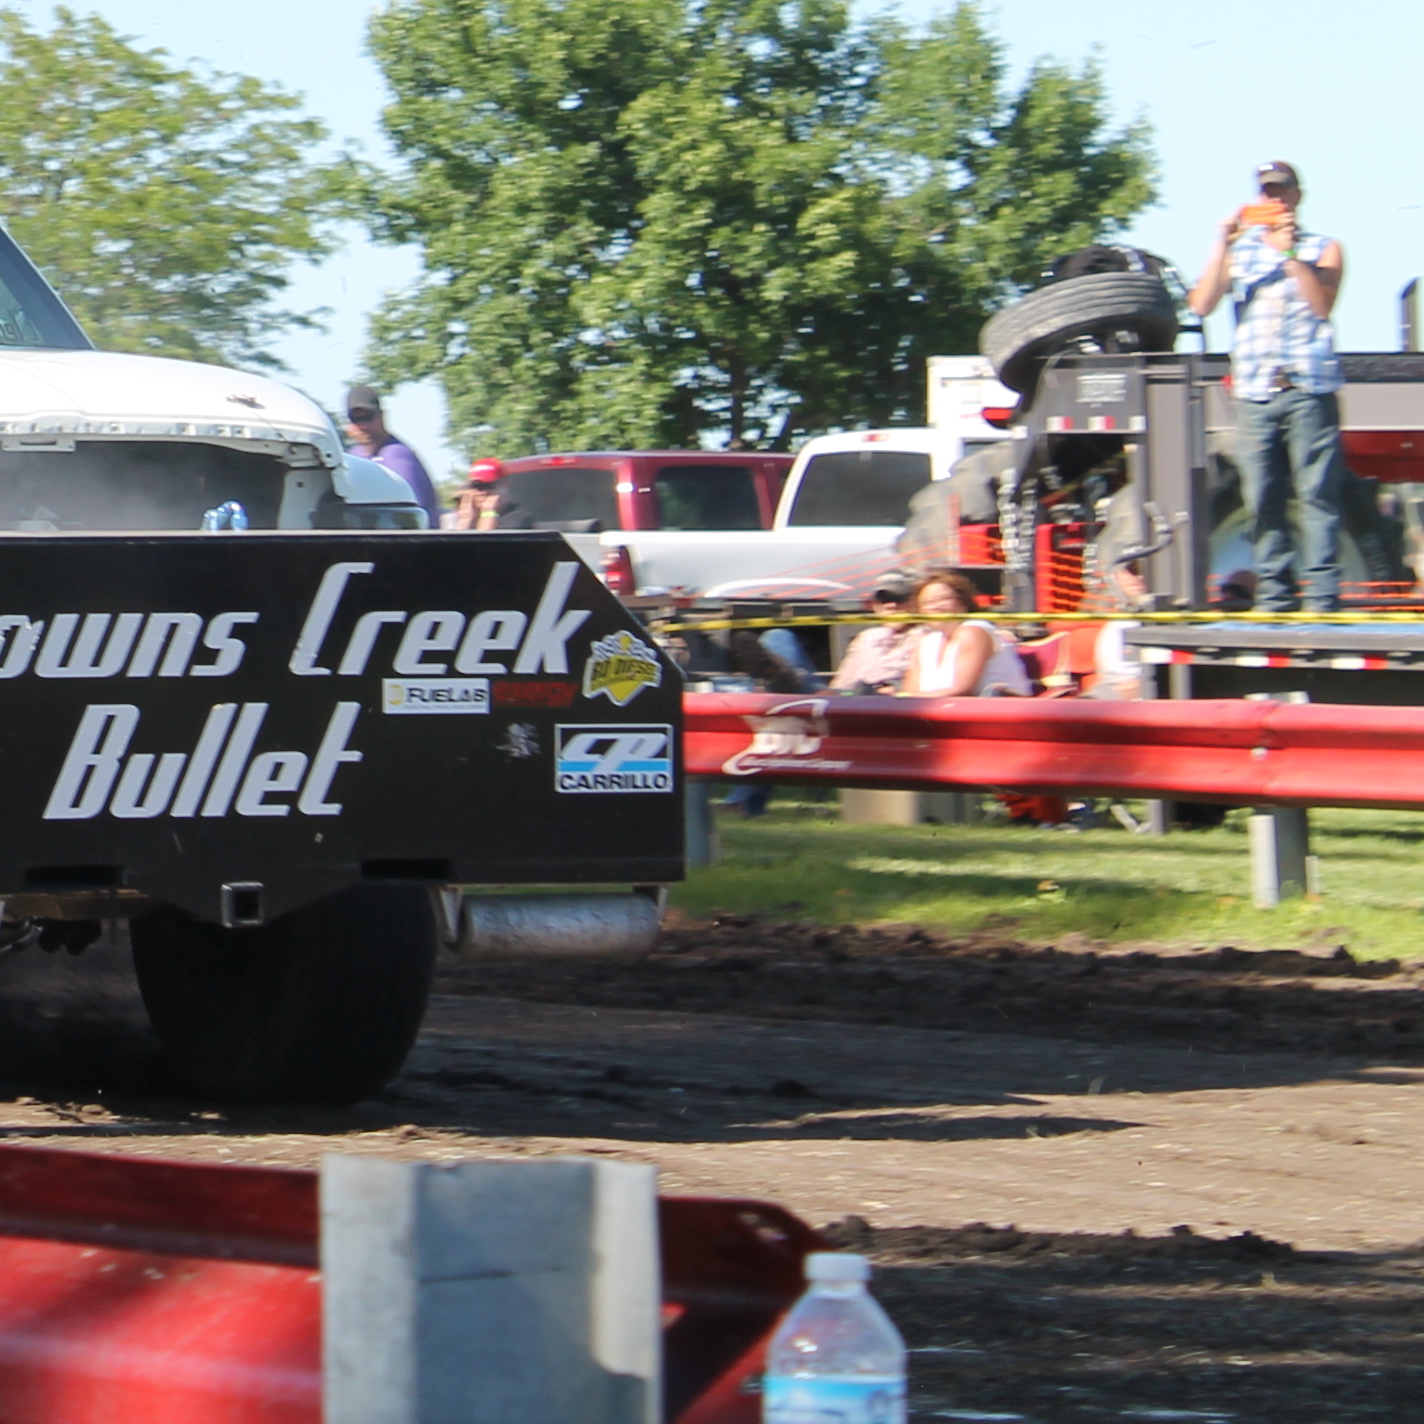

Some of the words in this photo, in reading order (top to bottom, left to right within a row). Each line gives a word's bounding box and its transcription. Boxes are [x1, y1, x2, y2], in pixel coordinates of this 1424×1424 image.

[289, 561, 593, 676] Creek
[406, 686, 487, 703] FUELAB
[42, 701, 364, 819] Bullet
[558, 773, 669, 791] CARRILLO
